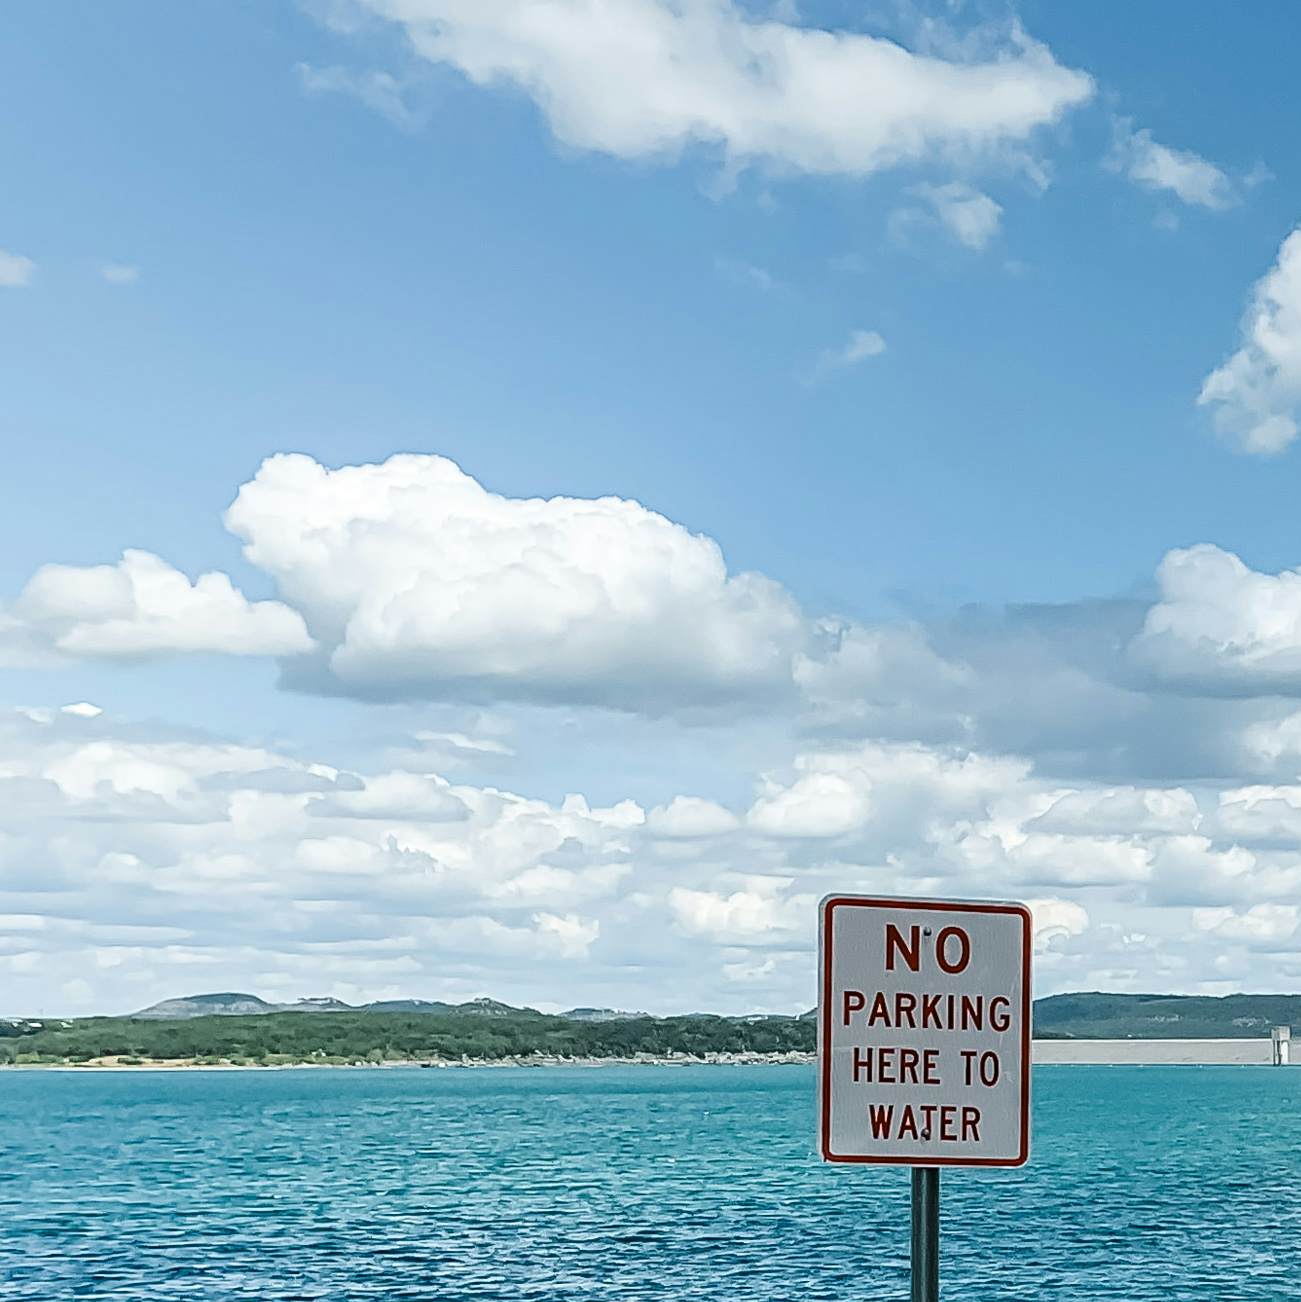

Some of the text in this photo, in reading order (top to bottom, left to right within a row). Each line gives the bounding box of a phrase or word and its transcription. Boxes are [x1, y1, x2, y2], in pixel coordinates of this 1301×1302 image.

[885, 923, 970, 974] NO
[843, 990, 1011, 1032] PARKING
[853, 1047, 1000, 1087] HERE TO
[868, 1104, 981, 1142] WATER
